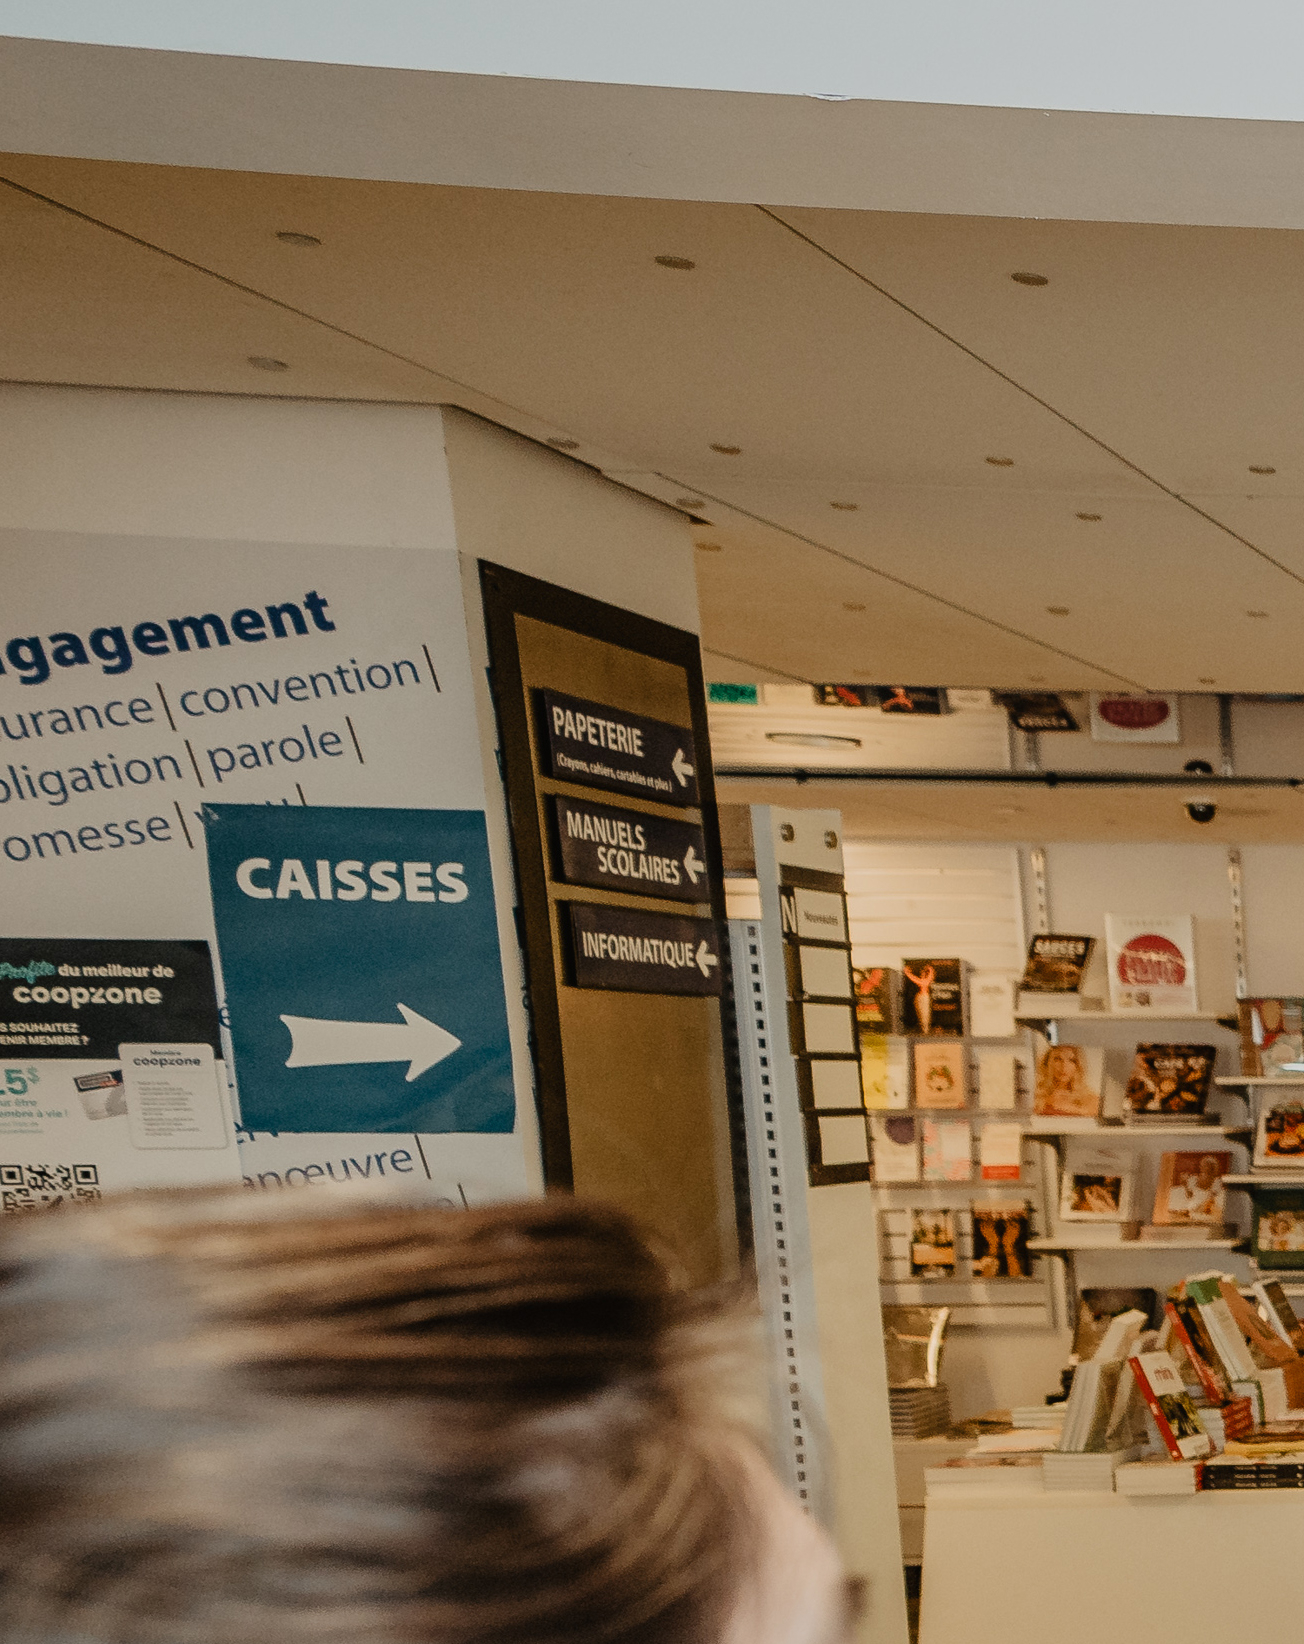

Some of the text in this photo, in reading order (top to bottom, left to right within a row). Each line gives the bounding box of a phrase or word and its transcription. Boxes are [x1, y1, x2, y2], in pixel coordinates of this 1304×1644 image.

[0, 590, 336, 686] gagement
[180, 658, 421, 717] convention
[552, 705, 645, 758] PAPETERIE
[207, 724, 343, 782] parole
[566, 811, 646, 851] MANUELS
[235, 857, 470, 904] CAISSES
[597, 846, 682, 885] SCOLAIRES
[582, 930, 696, 969] INFORMATIQUE
[58, 963, 81, 978] du
[82, 962, 150, 978] meilleur
[152, 964, 175, 979] de
[12, 986, 163, 1010] coopzone
[9, 1022, 81, 1034] SOUHAITEZ
[28, 1035, 81, 1046] MEMBRE
[133, 1056, 201, 1068] coopzone
